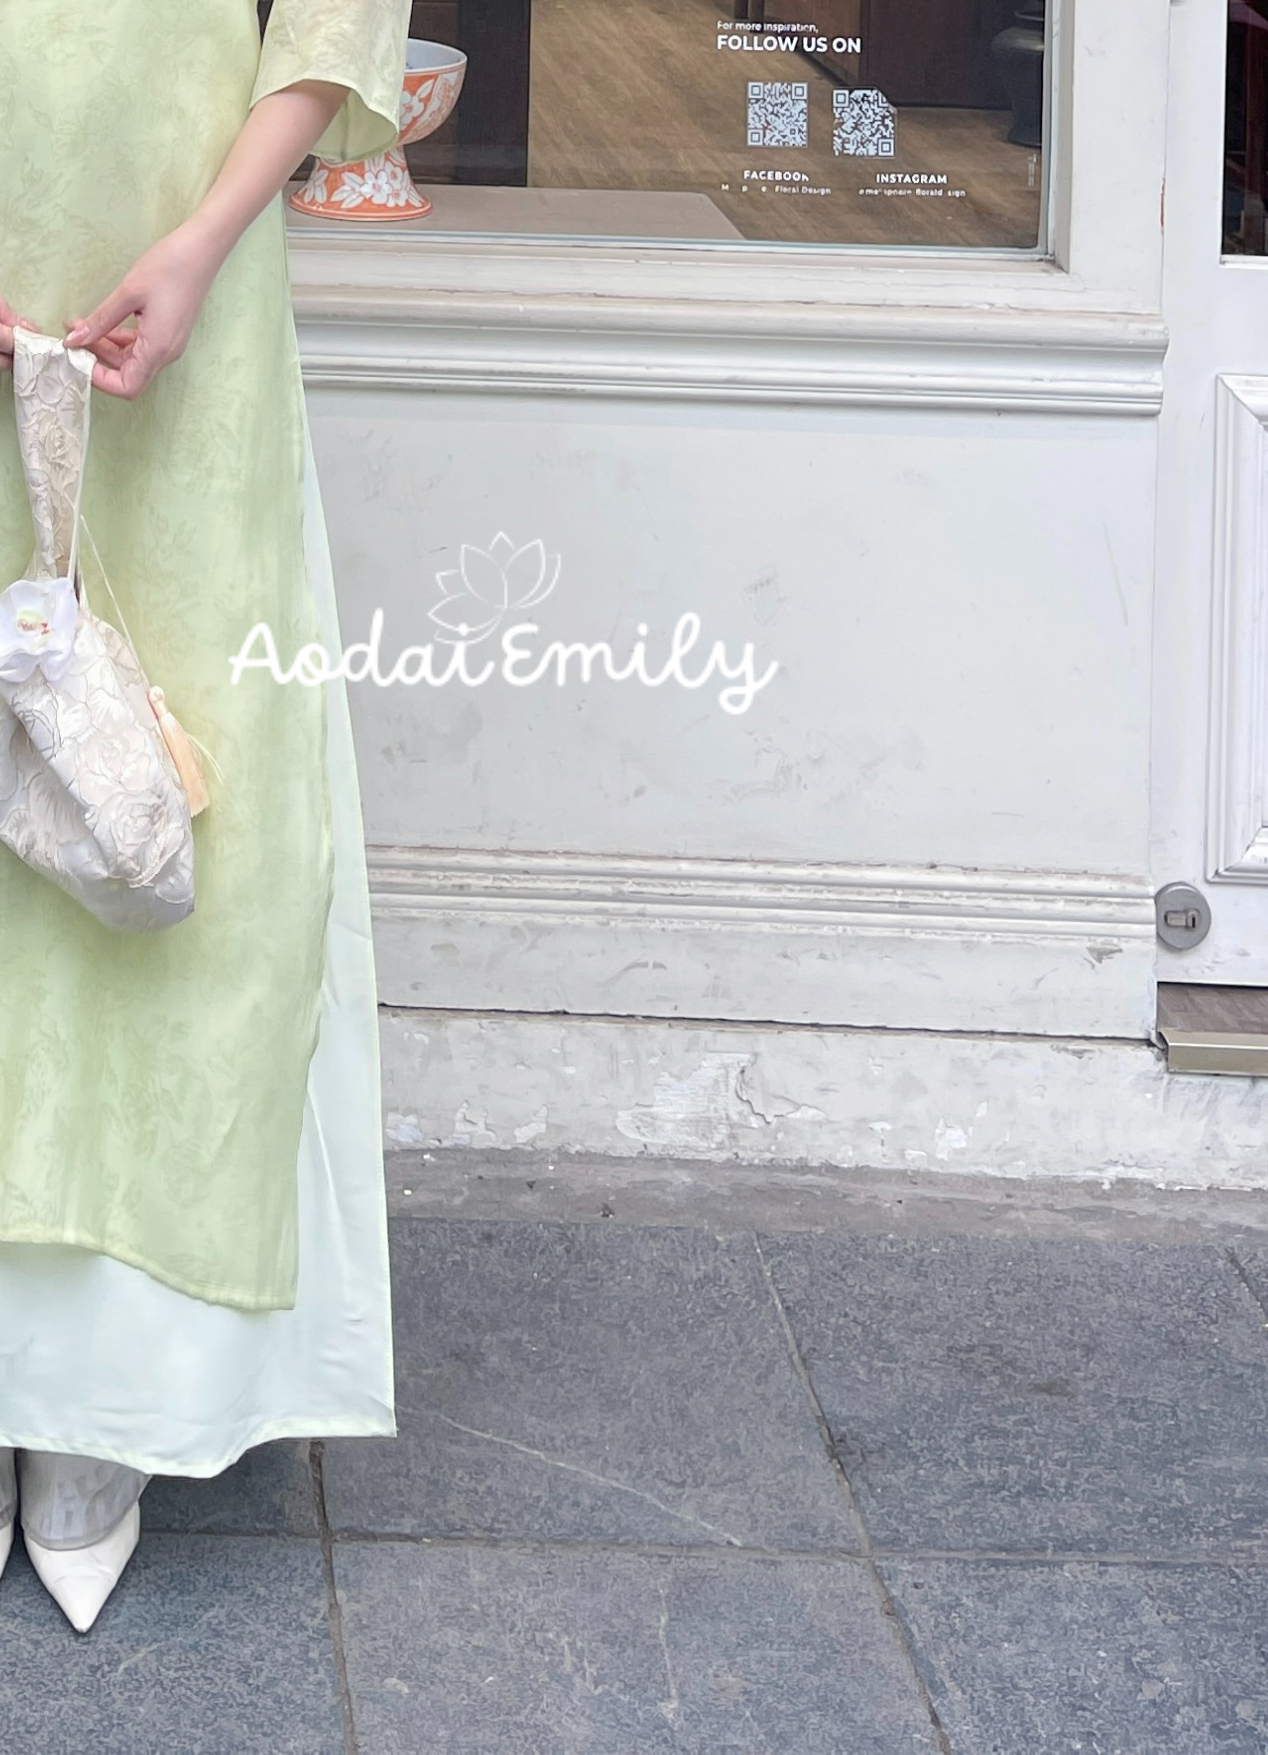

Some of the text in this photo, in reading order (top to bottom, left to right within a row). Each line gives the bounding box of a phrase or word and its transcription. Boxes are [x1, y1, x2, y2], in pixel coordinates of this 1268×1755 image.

[735, 22, 762, 31] more
[717, 34, 861, 54] FOLLOW US ON
[876, 173, 948, 184] INSTAGRAM
